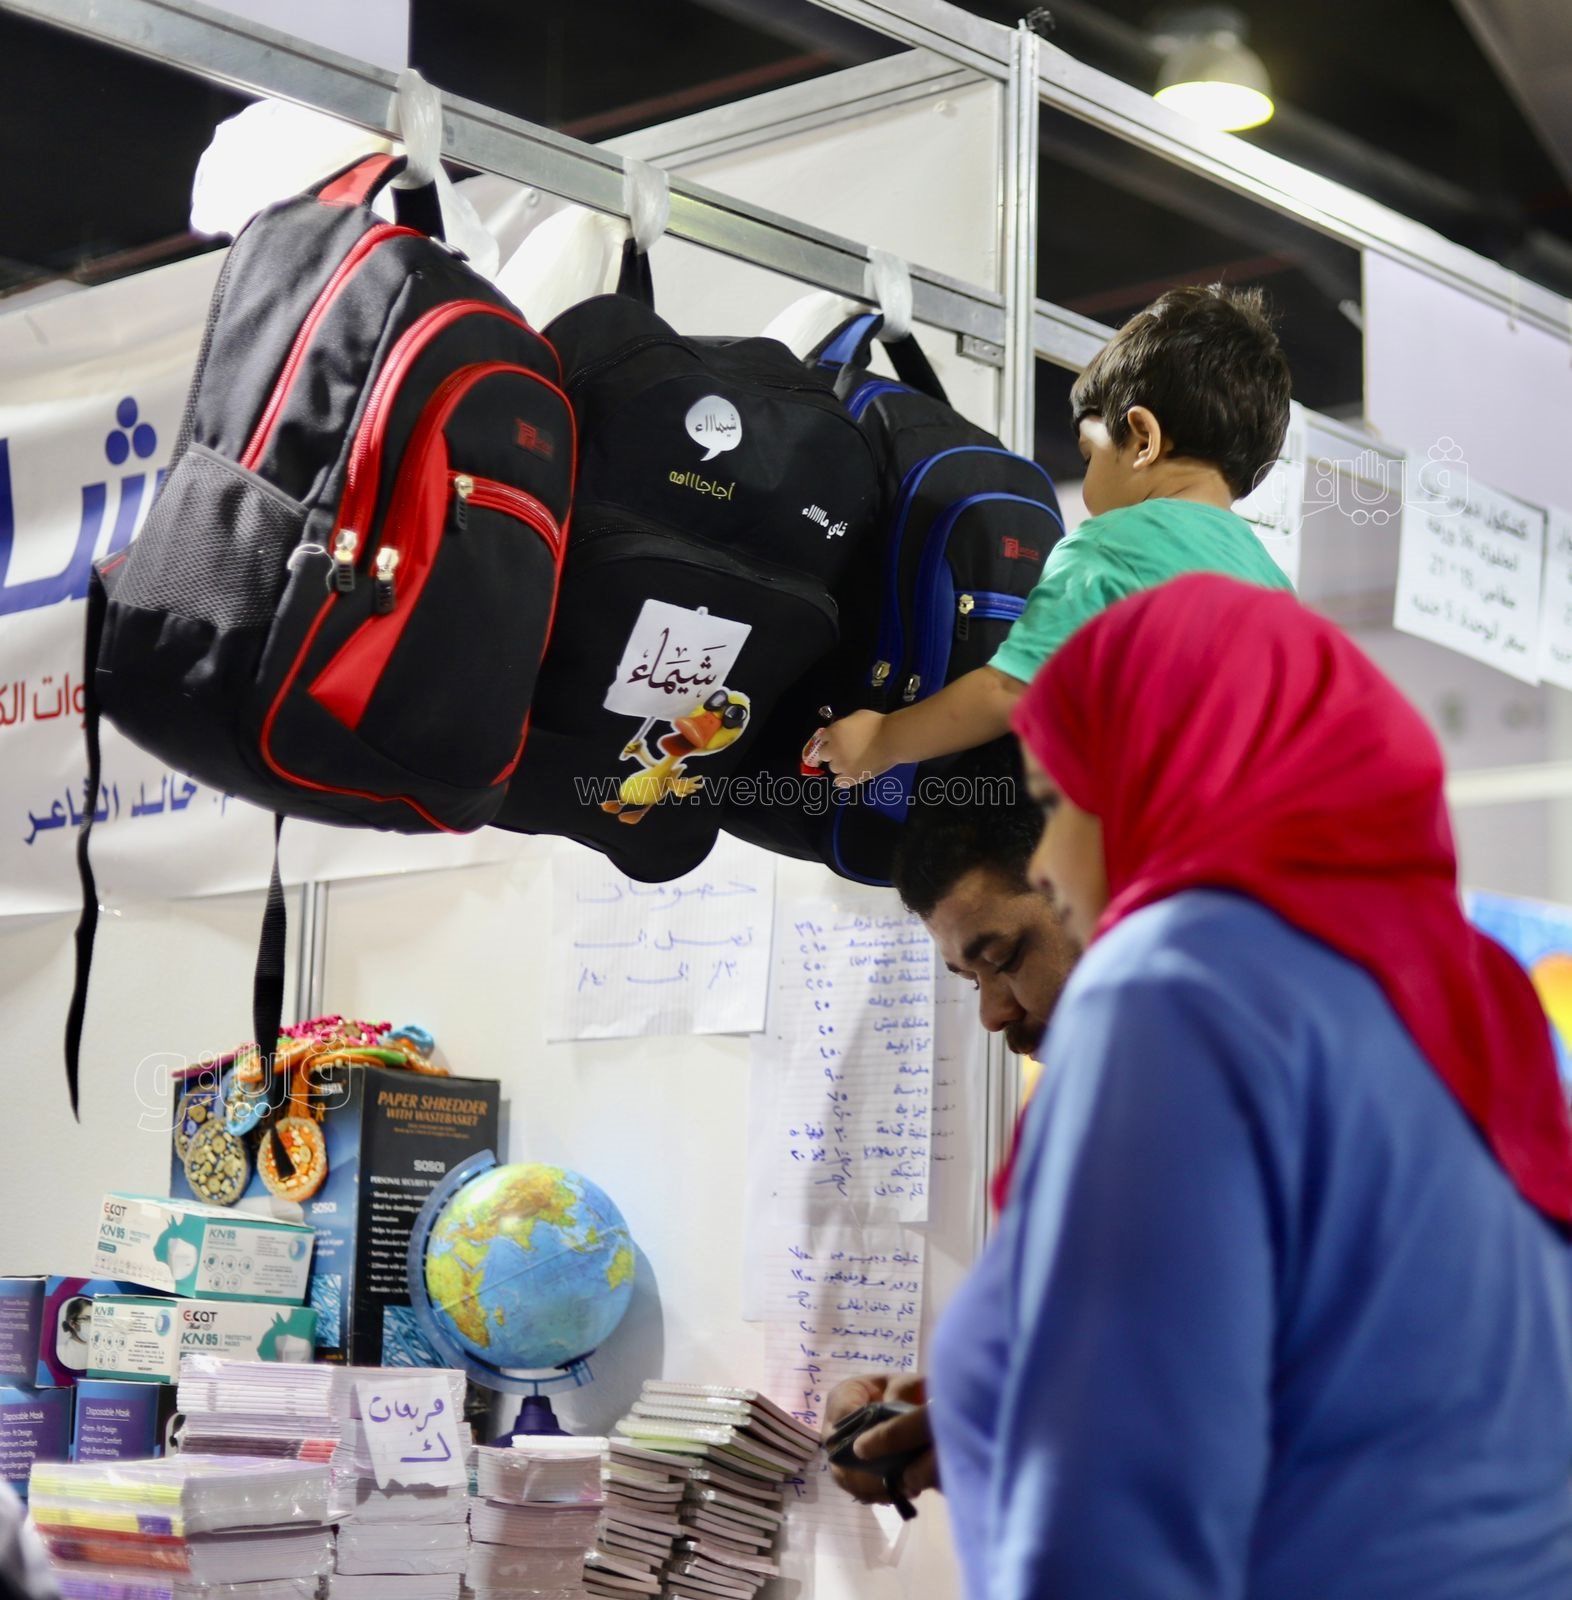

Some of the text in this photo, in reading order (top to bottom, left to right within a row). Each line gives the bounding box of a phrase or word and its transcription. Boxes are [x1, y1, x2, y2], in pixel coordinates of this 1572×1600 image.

[378, 1091, 488, 1116] PAPER SHREDDER
[387, 1108, 479, 1126] WITH WASTEBASKET
[181, 1332, 218, 1345] KN95
